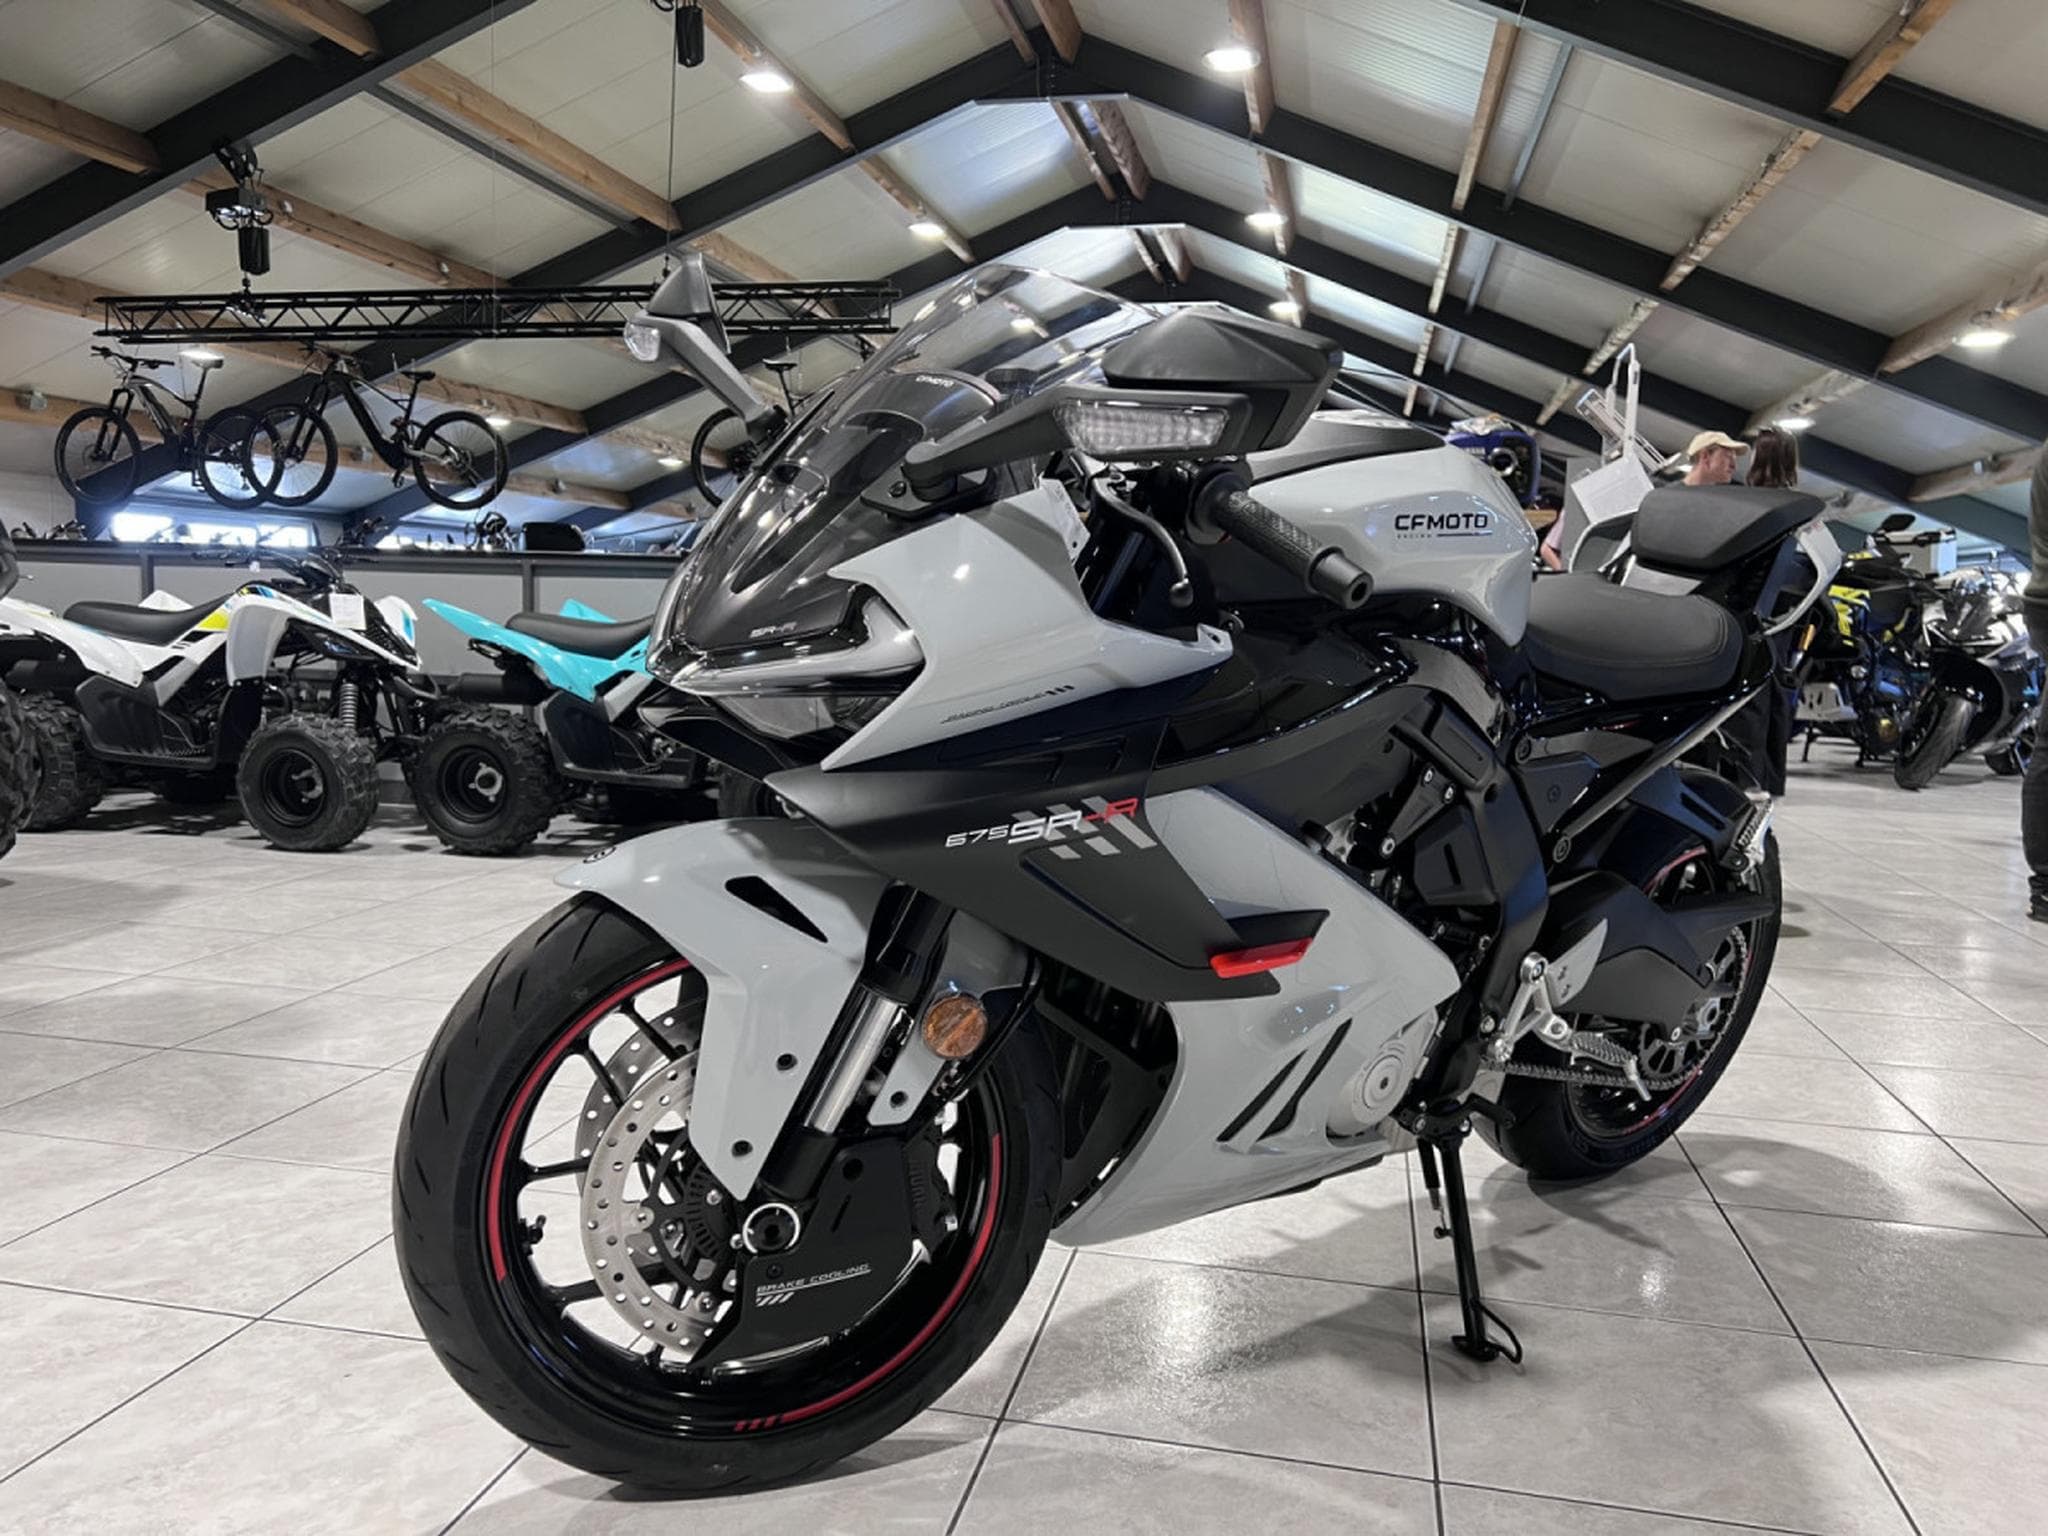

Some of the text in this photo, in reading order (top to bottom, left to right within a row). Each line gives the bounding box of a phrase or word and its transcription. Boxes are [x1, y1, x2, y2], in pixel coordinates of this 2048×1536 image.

[1394, 513, 1488, 530] CFMOTO
[756, 1263, 870, 1293] BRAKE COOLING
